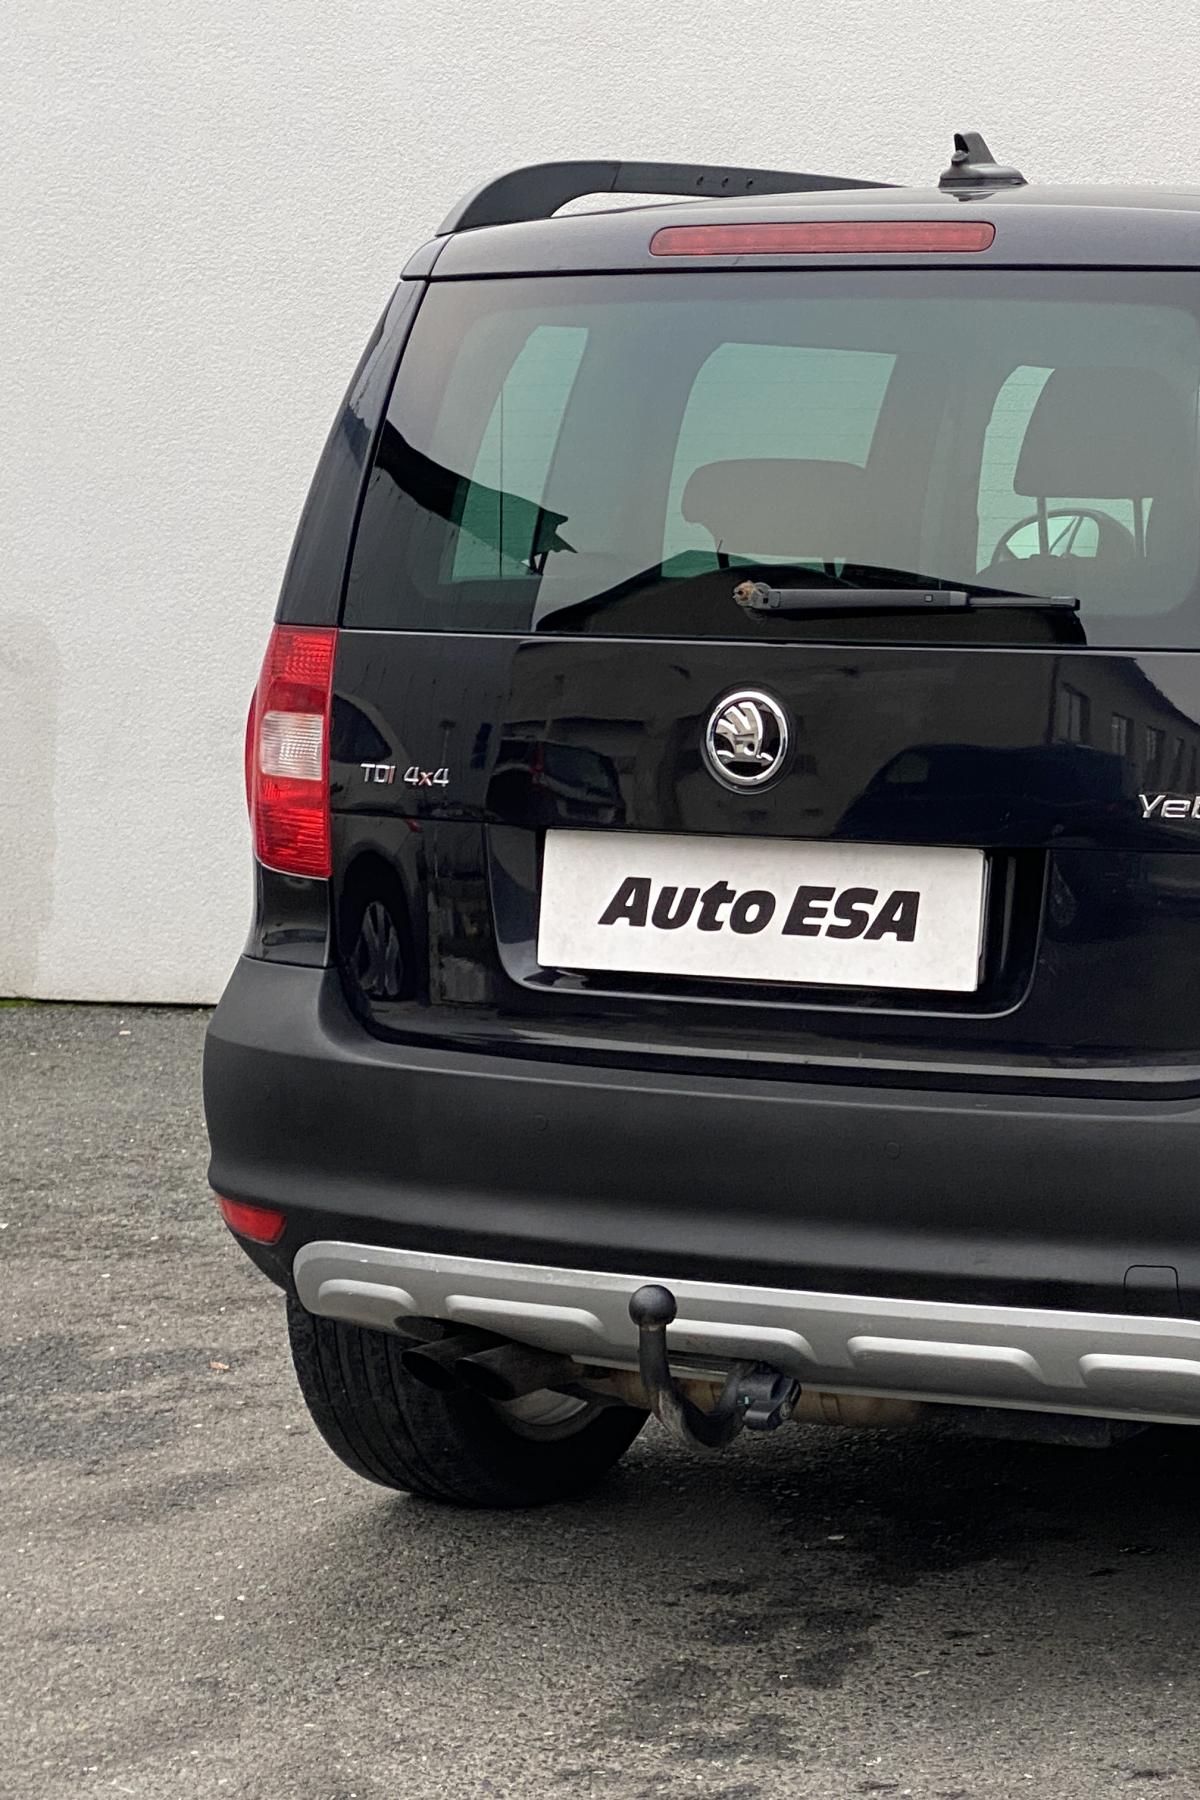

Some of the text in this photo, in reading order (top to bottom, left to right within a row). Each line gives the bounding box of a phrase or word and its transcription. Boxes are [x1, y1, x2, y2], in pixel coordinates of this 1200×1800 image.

[361, 763, 449, 787] TDI 4x4
[598, 876, 920, 942] Auto ESA
